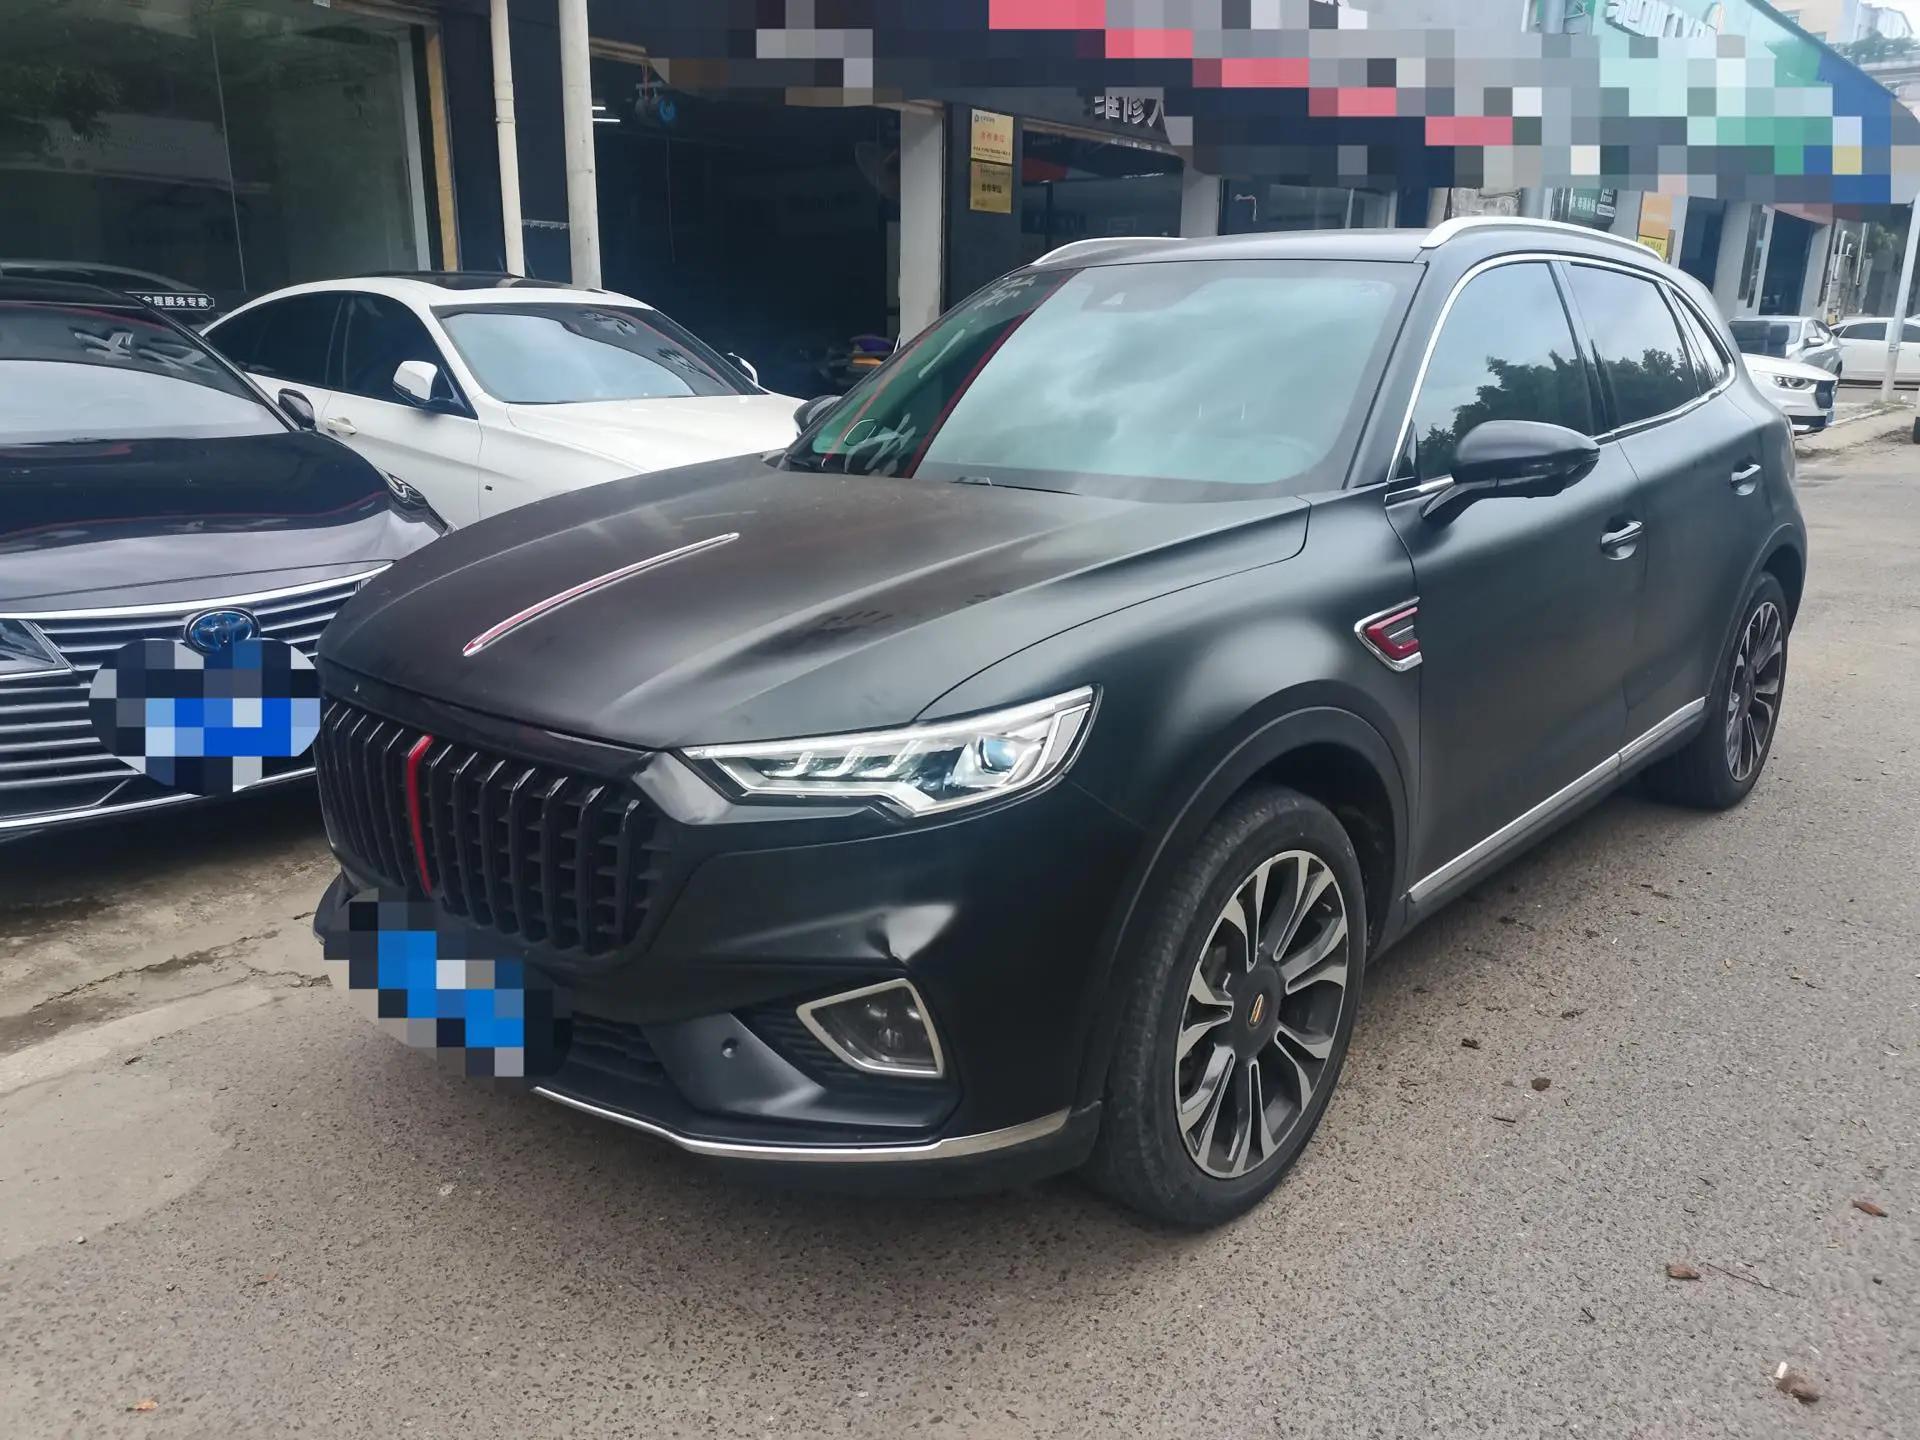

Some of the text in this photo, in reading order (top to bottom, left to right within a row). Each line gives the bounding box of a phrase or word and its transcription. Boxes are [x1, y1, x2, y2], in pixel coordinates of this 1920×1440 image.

[136, 295, 208, 306] 全程服务专家
